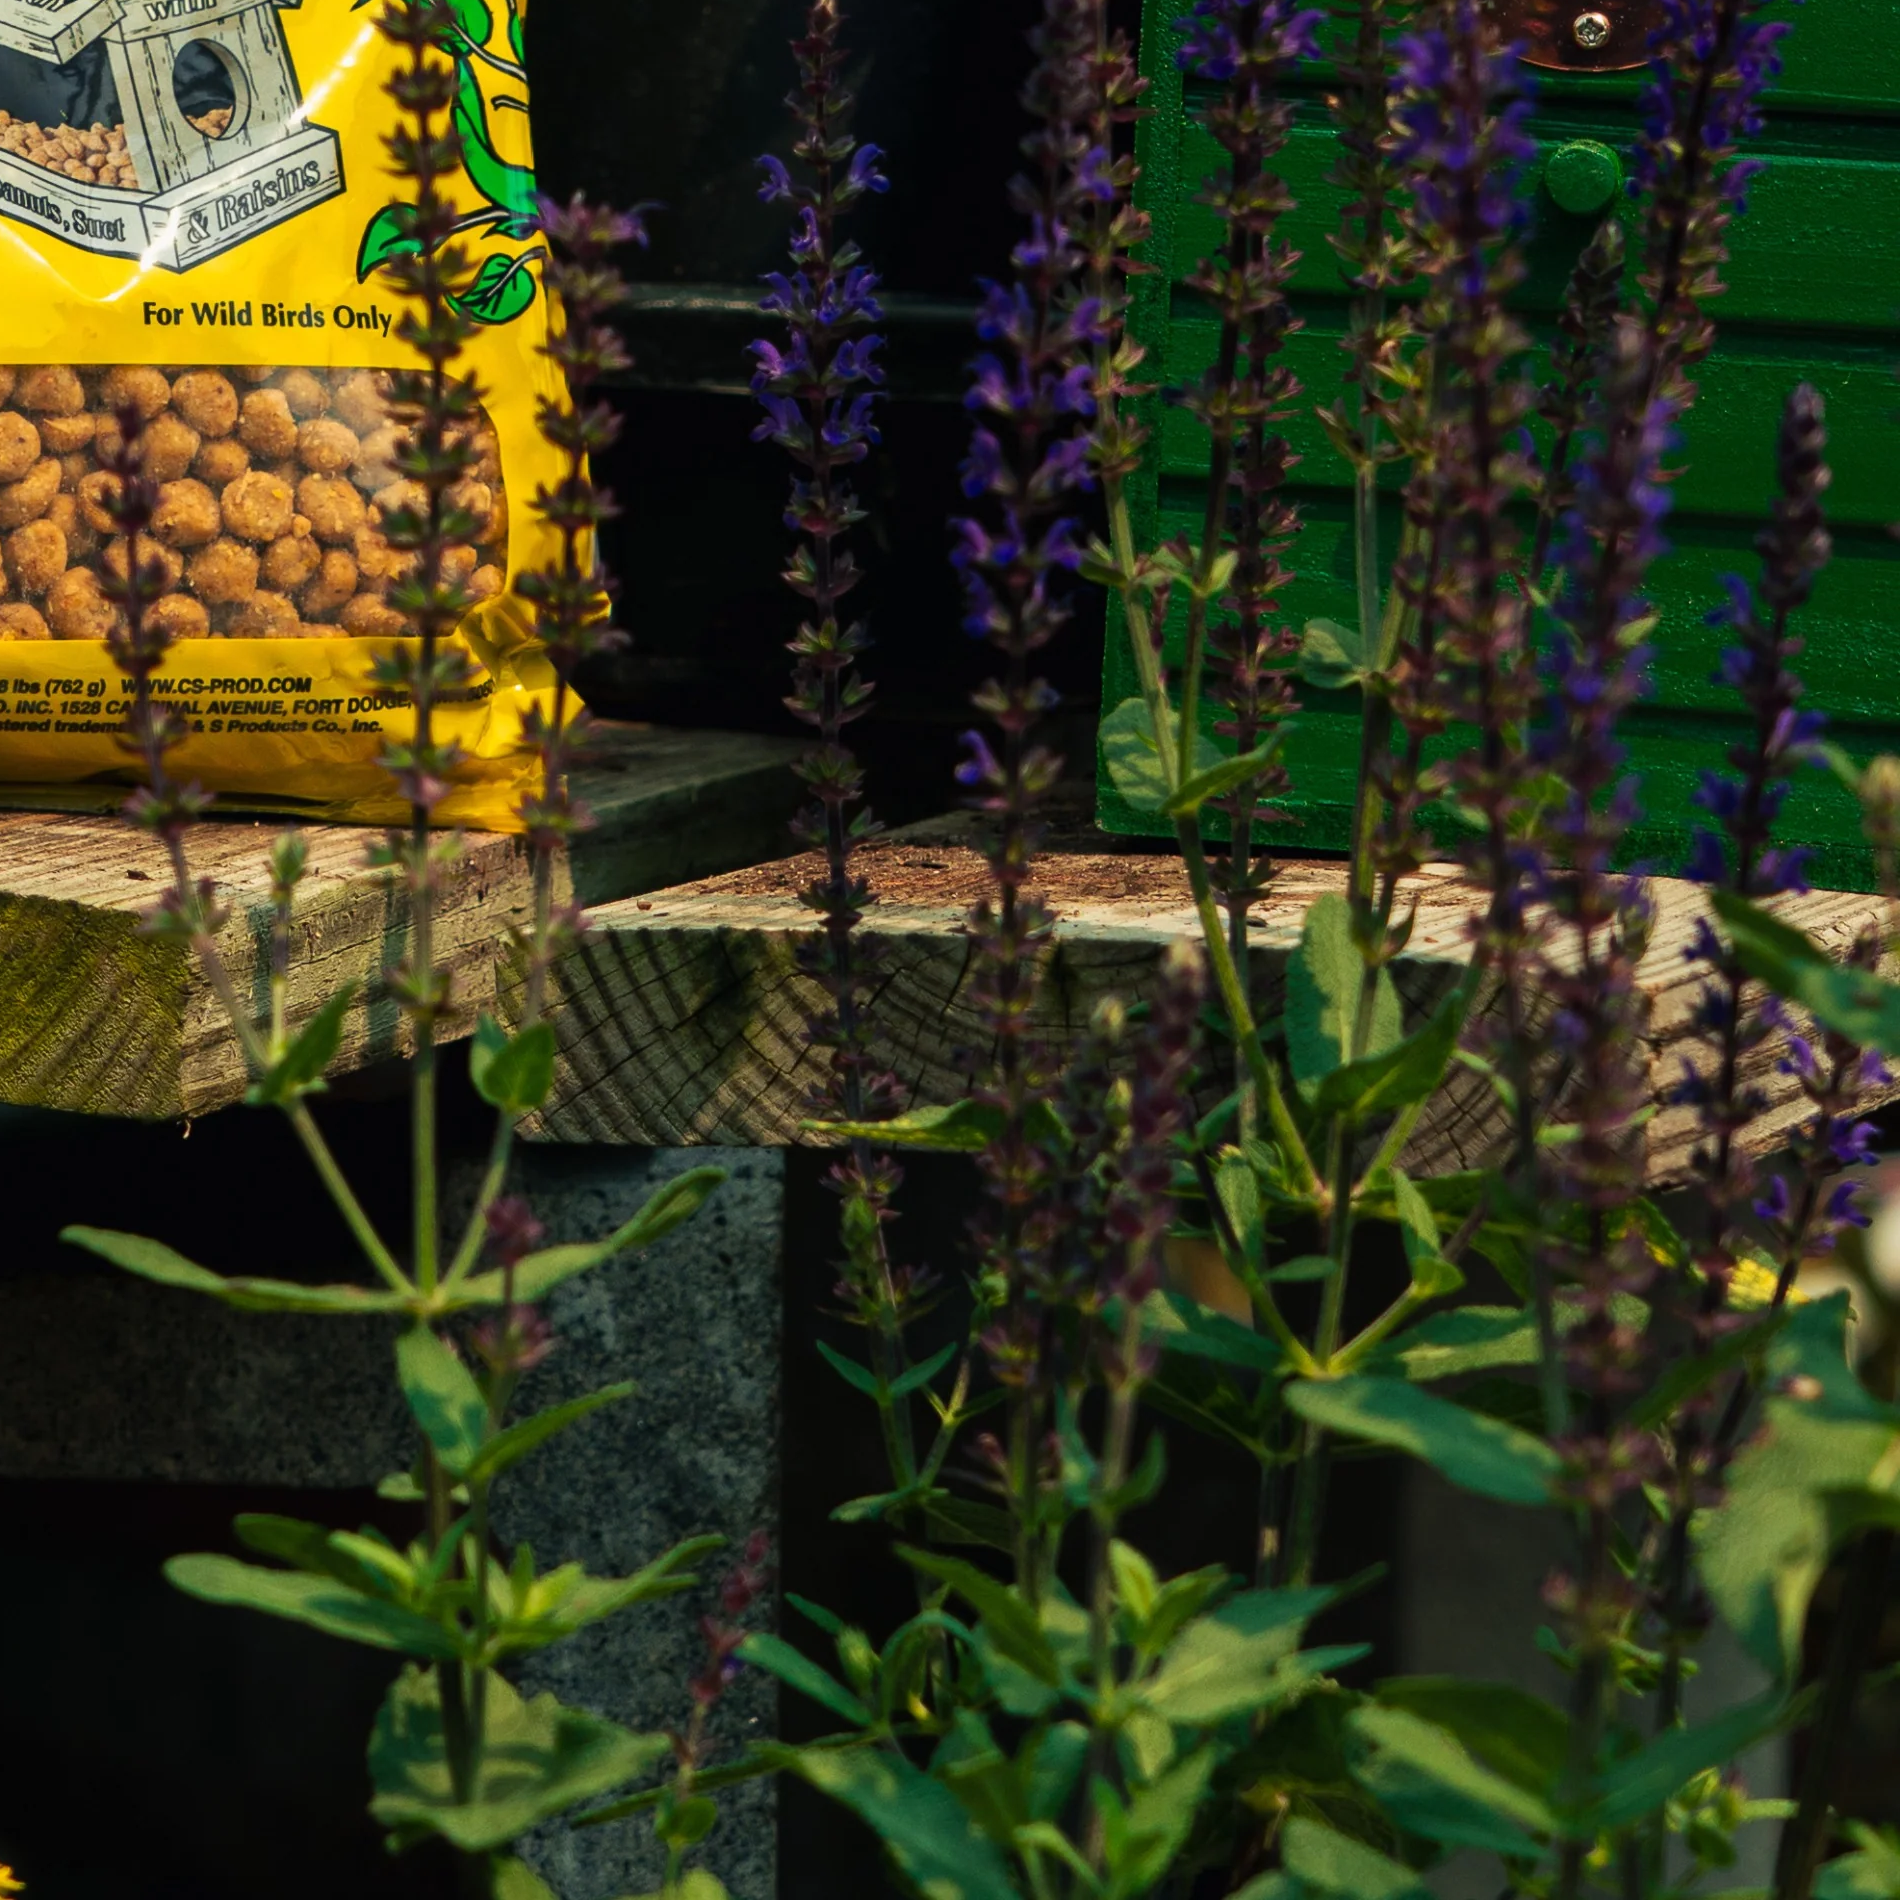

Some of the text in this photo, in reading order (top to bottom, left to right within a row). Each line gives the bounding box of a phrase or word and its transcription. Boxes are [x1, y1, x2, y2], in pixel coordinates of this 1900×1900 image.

[187, 159, 322, 245] & Raisins
[72, 207, 127, 242] Suet
[143, 300, 392, 338] For Wild Birds Only
[13, 678, 40, 694] lbs
[45, 678, 84, 698] (762
[87, 678, 106, 698] g)
[15, 699, 54, 714] INC.
[60, 700, 101, 715] 1528
[206, 700, 288, 717] AVENUE,
[292, 699, 345, 715] FORT
[192, 719, 205, 733] &
[209, 719, 224, 733] S
[227, 719, 308, 733] Products
[311, 718, 347, 734] Co.,
[351, 718, 383, 733] Inc.
